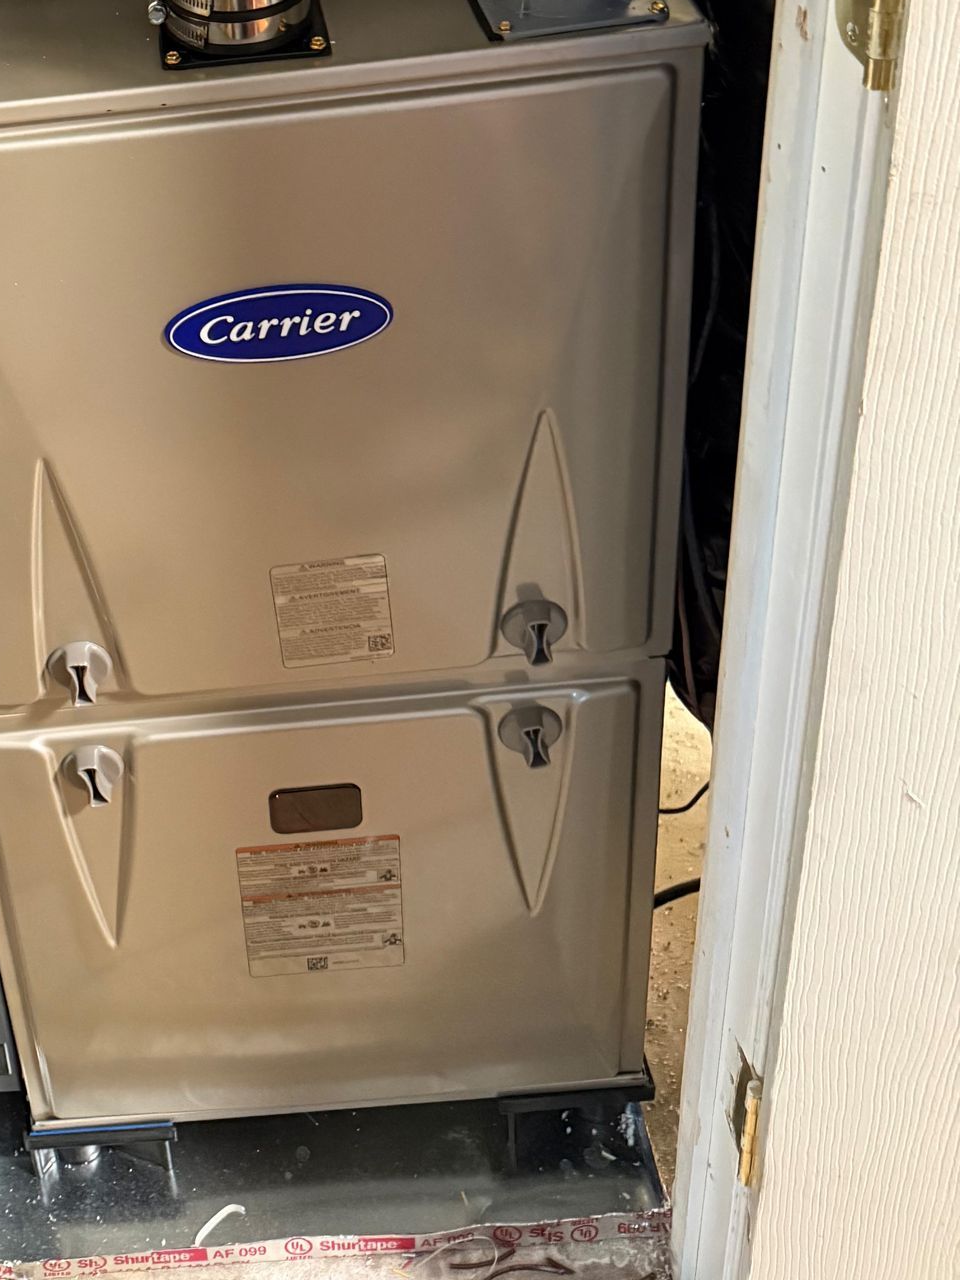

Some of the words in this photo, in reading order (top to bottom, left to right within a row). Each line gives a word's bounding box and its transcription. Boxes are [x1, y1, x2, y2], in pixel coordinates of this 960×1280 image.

[199, 309, 360, 345] Carrier
[319, 1239, 398, 1251] Shurtape
[421, 1237, 442, 1248] AF
[113, 1252, 190, 1265] Shurtape
[213, 1249, 235, 1259] AF
[239, 1246, 267, 1257] 099
